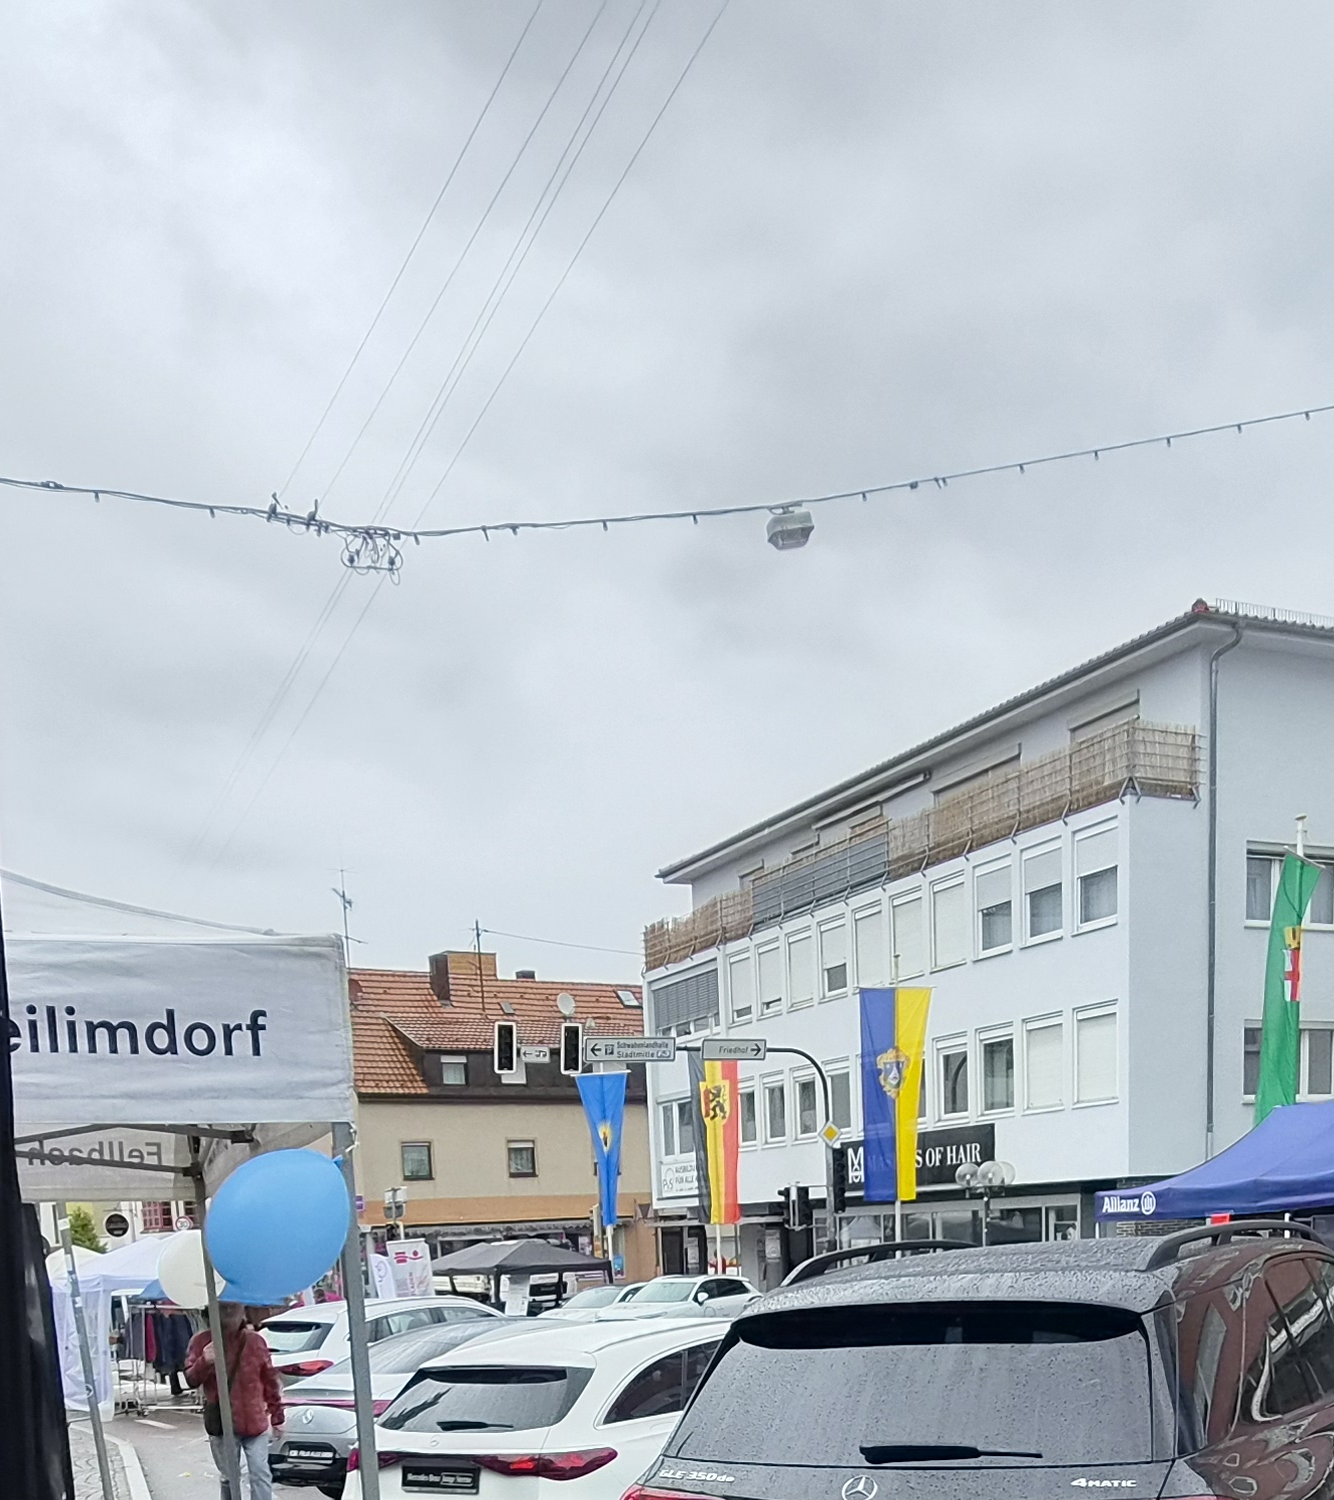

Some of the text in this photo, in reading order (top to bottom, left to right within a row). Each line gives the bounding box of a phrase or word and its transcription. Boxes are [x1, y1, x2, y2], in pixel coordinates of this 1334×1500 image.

[5, 1003, 268, 1057] eilimdorf
[616, 1050, 655, 1058] Stadtmitte
[719, 1046, 749, 1054] Friedhof
[925, 1147, 944, 1167] OF
[946, 1143, 982, 1165] HAIR
[1102, 1196, 1140, 1213] Allianz
[659, 1469, 686, 1480] GLE
[1070, 1477, 1137, 1488] 4MATIC
